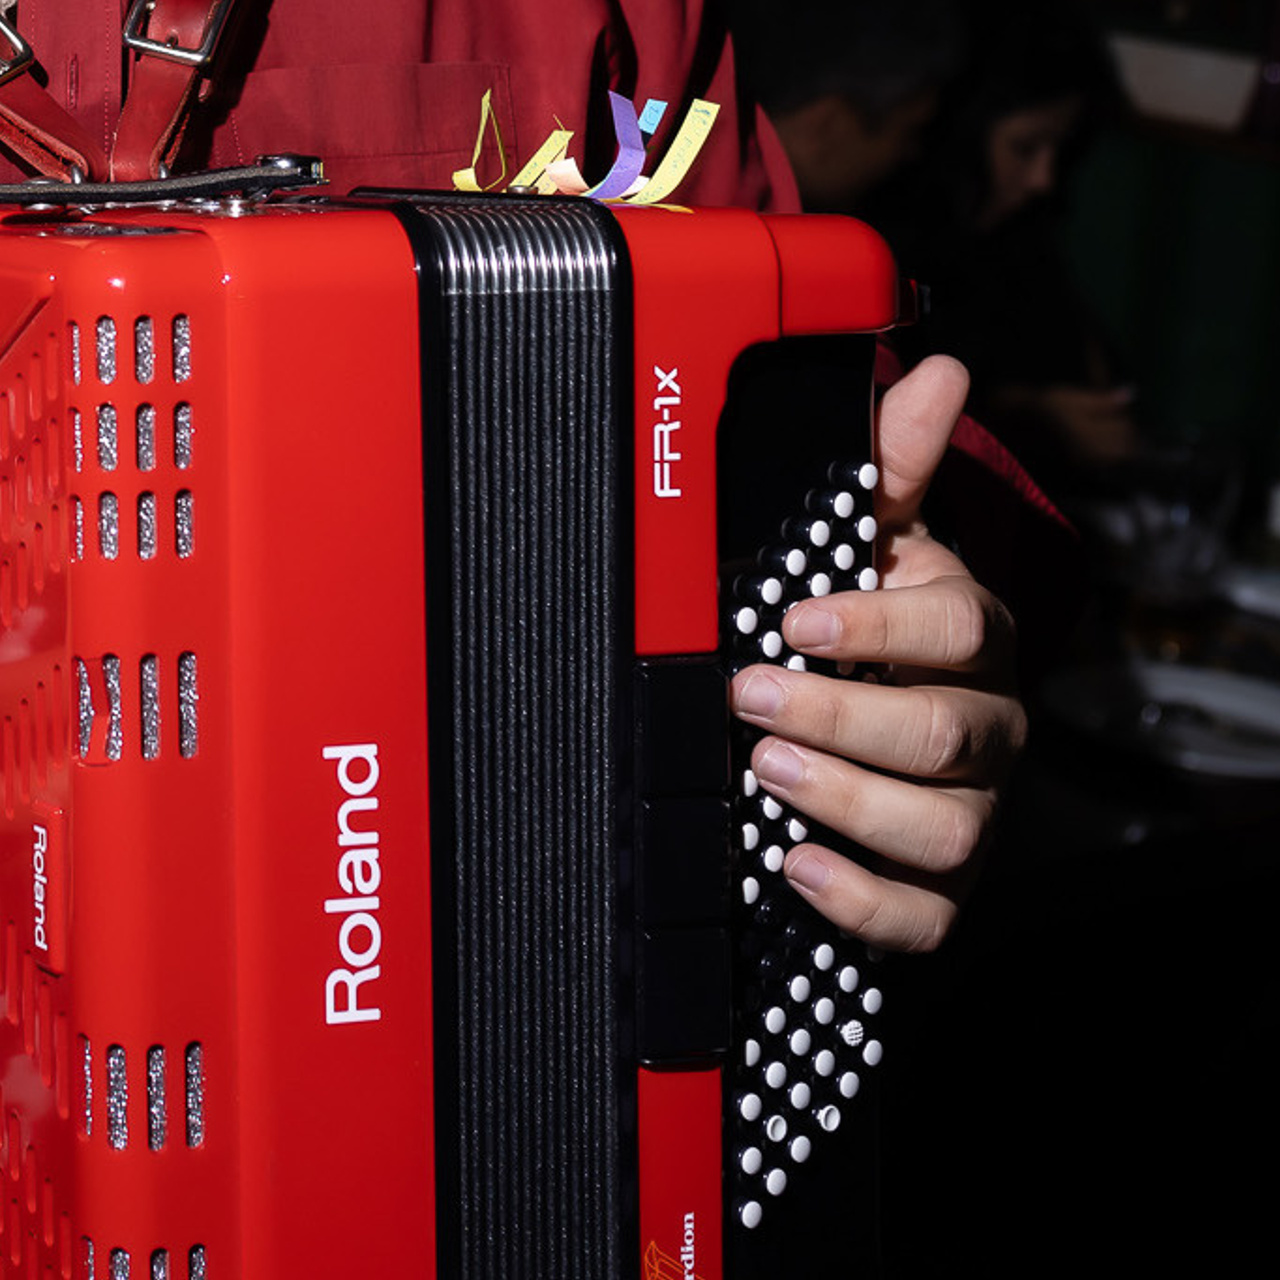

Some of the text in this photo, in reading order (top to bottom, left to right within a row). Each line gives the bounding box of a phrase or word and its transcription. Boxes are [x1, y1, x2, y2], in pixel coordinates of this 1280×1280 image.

[653, 365, 681, 497] FR-1x
[33, 825, 48, 951] Roland
[322, 743, 382, 1025] Roland
